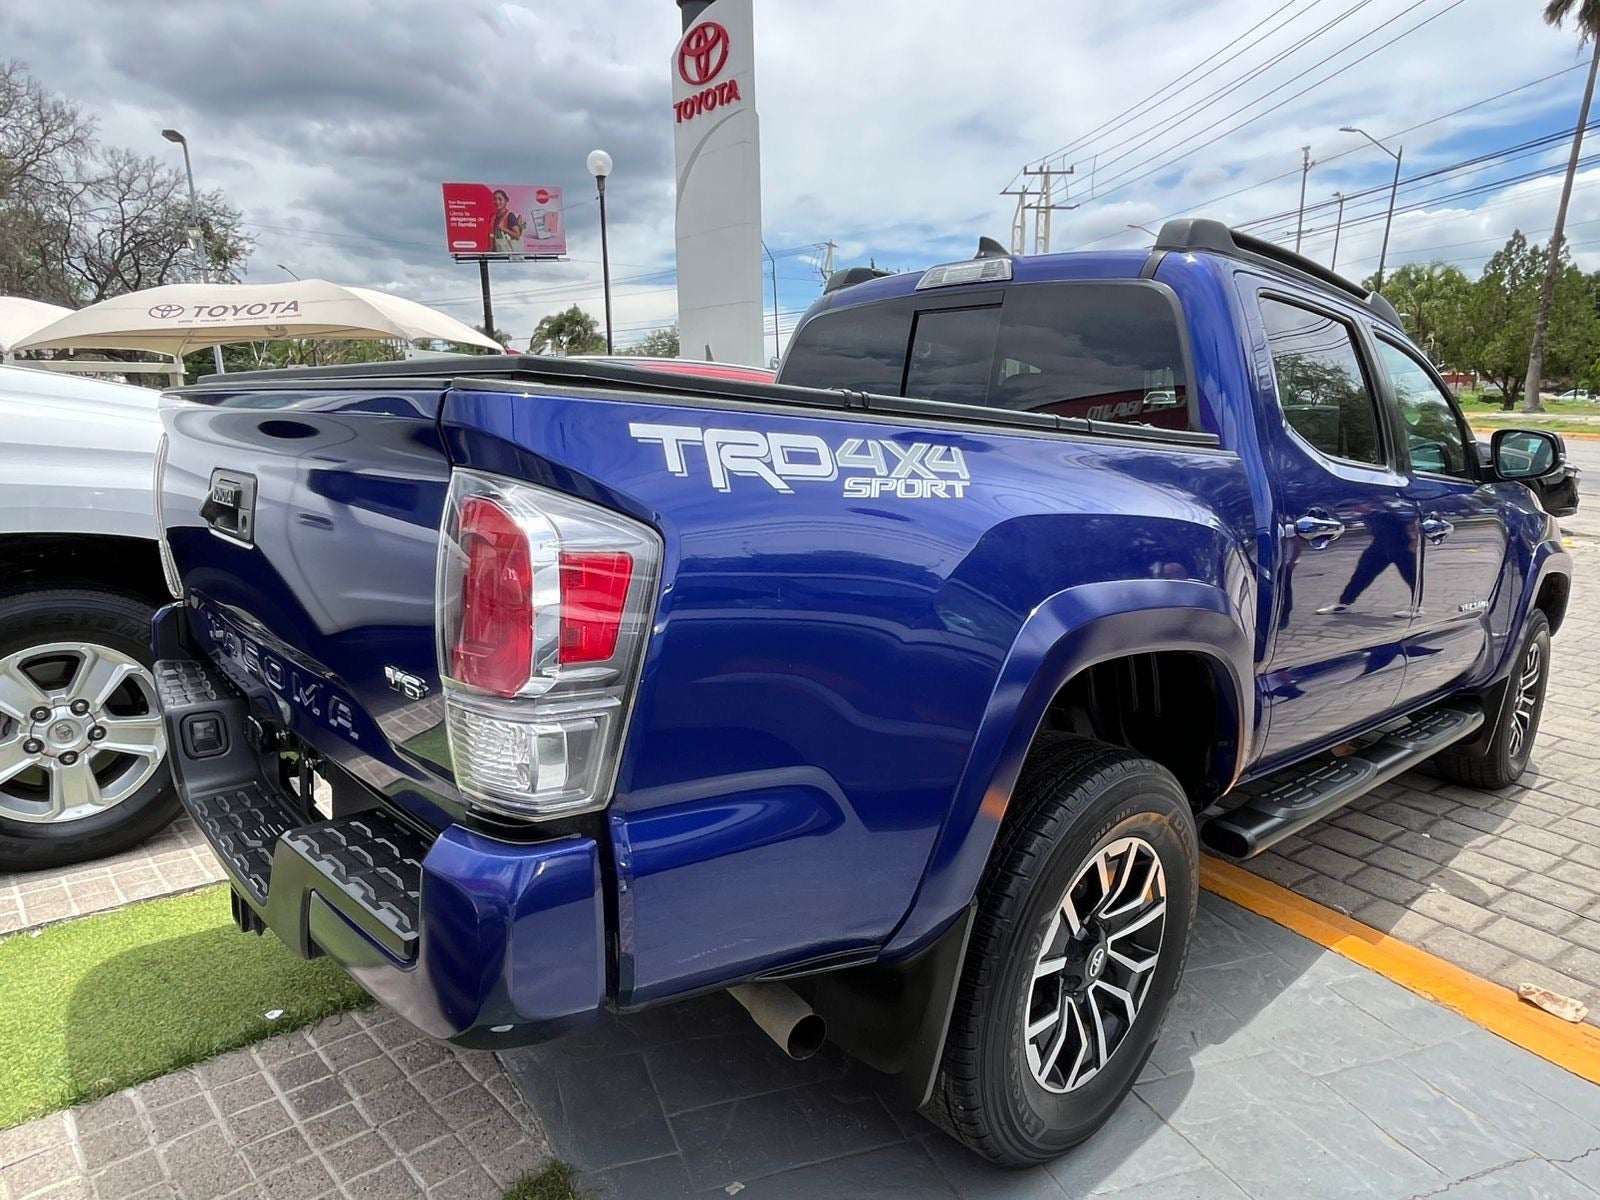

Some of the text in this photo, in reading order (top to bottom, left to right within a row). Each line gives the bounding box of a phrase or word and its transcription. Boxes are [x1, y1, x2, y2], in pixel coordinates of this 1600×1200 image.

[673, 79, 741, 124] TOYOTA
[193, 300, 299, 318] TOYOTA
[628, 422, 971, 494] TRD 4X4
[843, 477, 971, 498] SPORT
[384, 664, 429, 701] V6
